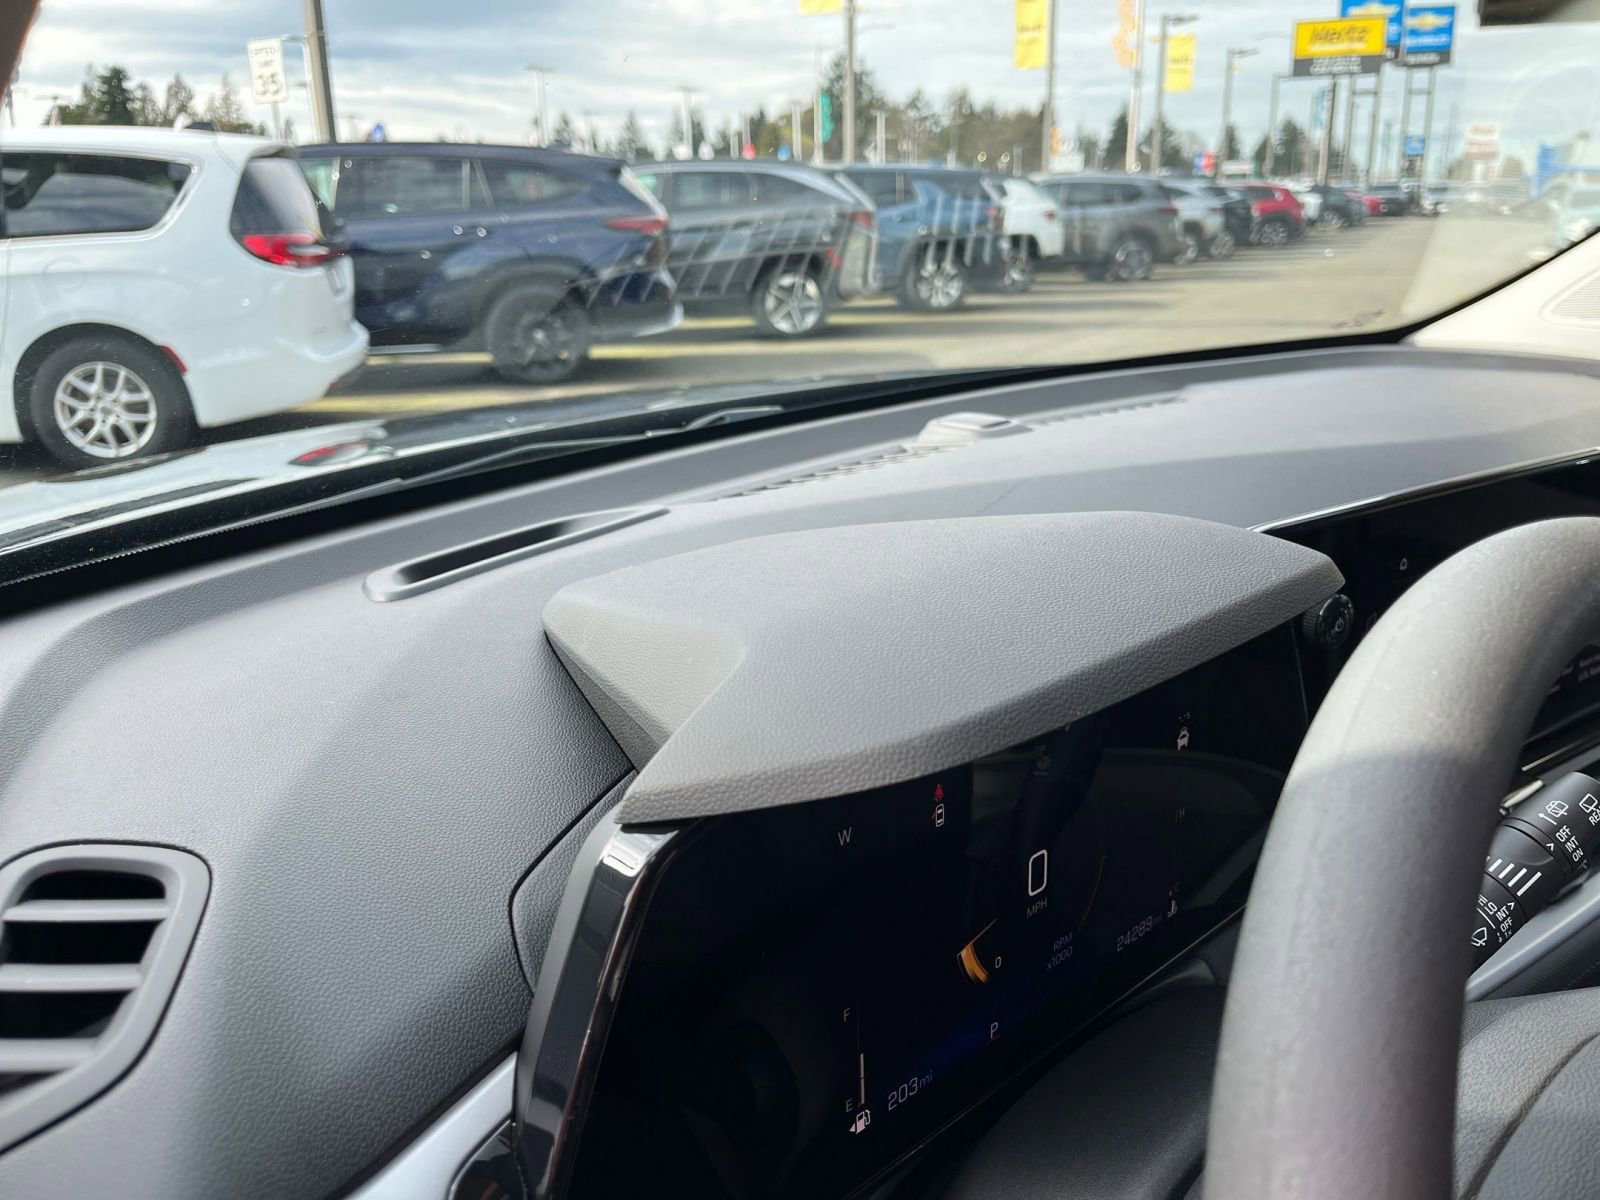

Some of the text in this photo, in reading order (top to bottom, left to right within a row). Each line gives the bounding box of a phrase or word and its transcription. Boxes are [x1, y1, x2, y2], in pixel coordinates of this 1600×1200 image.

[1310, 24, 1369, 43] Hertz
[255, 72, 284, 97] 35
[838, 825, 853, 847] W
[1555, 825, 1571, 842] OFF
[1564, 836, 1579, 853] INT
[1572, 848, 1584, 862] ON
[1025, 897, 1048, 920] MPH
[1484, 901, 1498, 916] LO
[1495, 905, 1509, 922] INT
[1500, 916, 1513, 933] OFF
[1053, 931, 1073, 953] RPM
[843, 1007, 851, 1023] F
[989, 1021, 999, 1040] P
[845, 1098, 853, 1112] E
